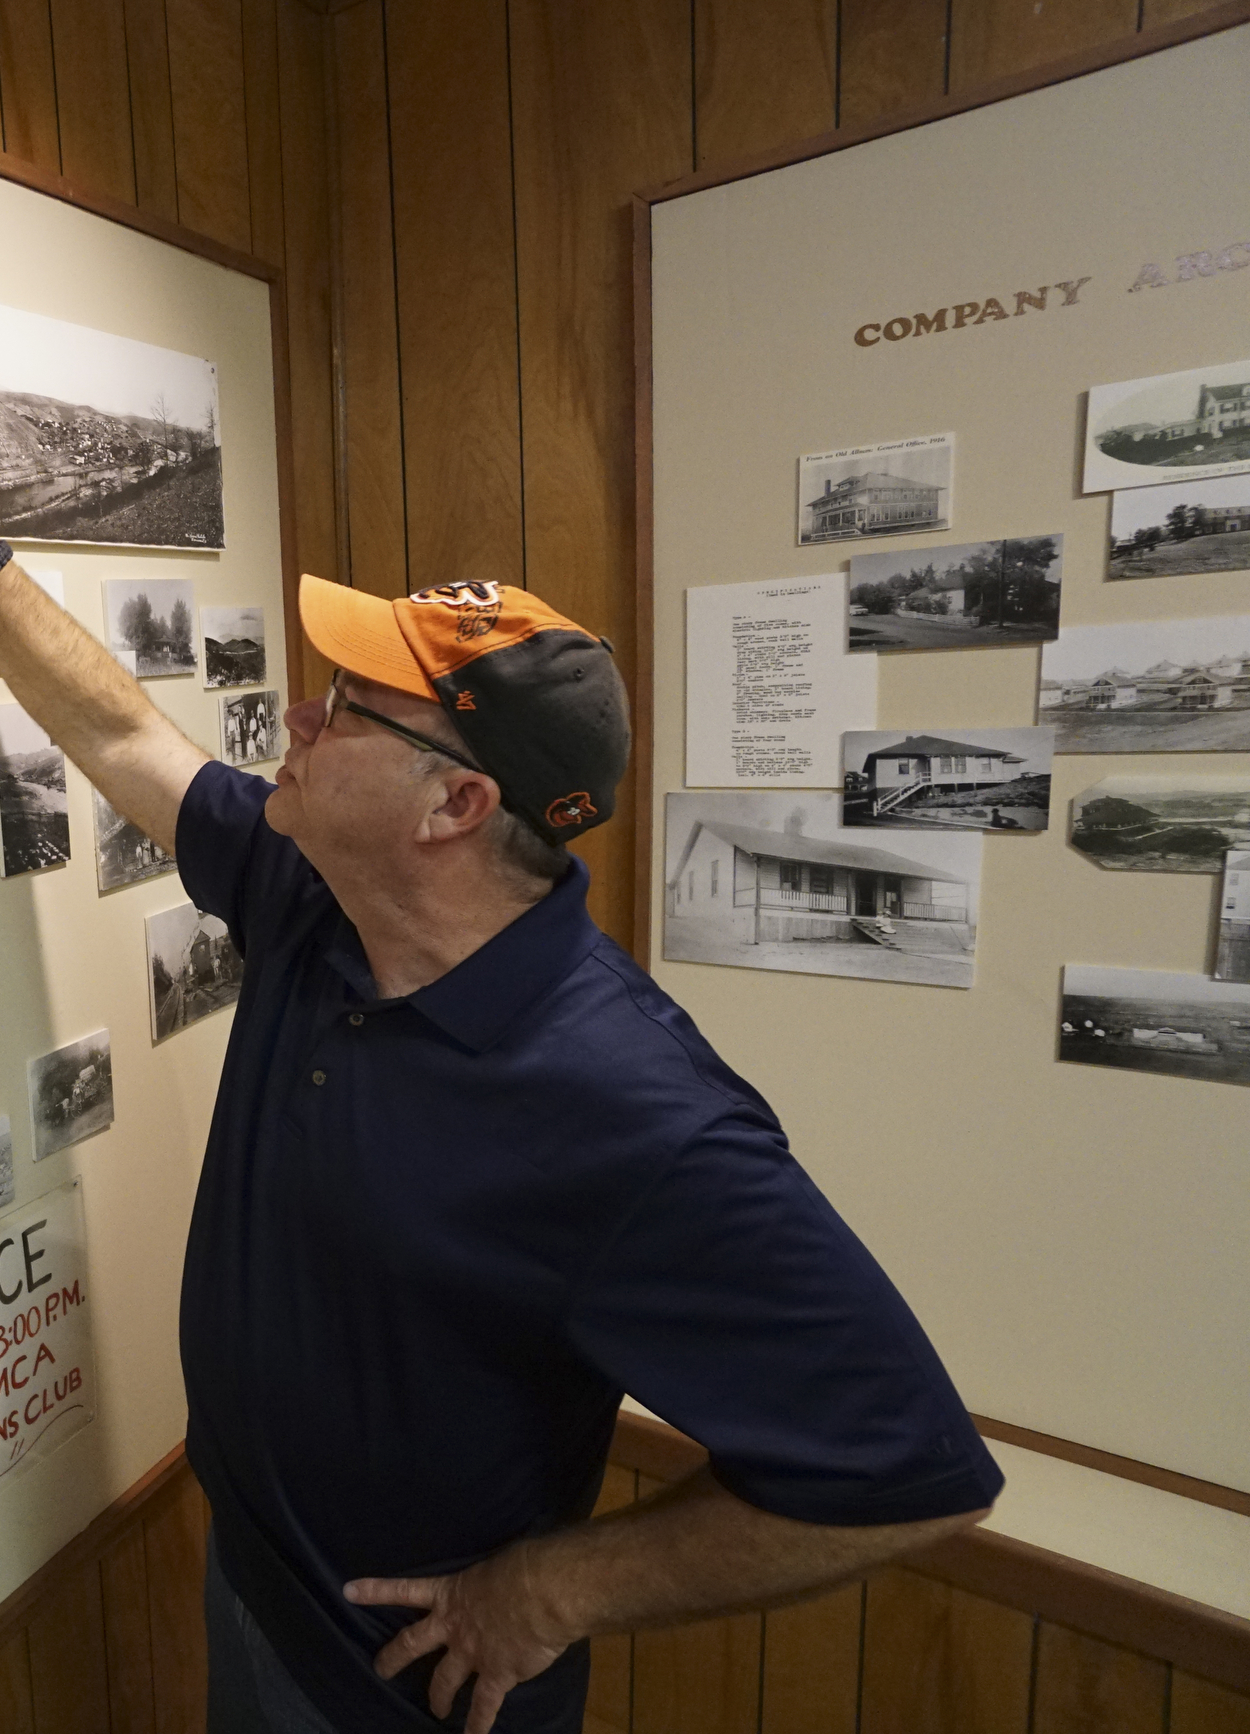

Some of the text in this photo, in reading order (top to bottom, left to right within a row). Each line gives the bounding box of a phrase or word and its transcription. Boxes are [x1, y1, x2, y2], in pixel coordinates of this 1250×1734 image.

[854, 276, 1092, 347] COMPANY
[877, 442, 904, 451] General
[44, 1279, 86, 1329] P.M.
[24, 1366, 82, 1426] CLUB
